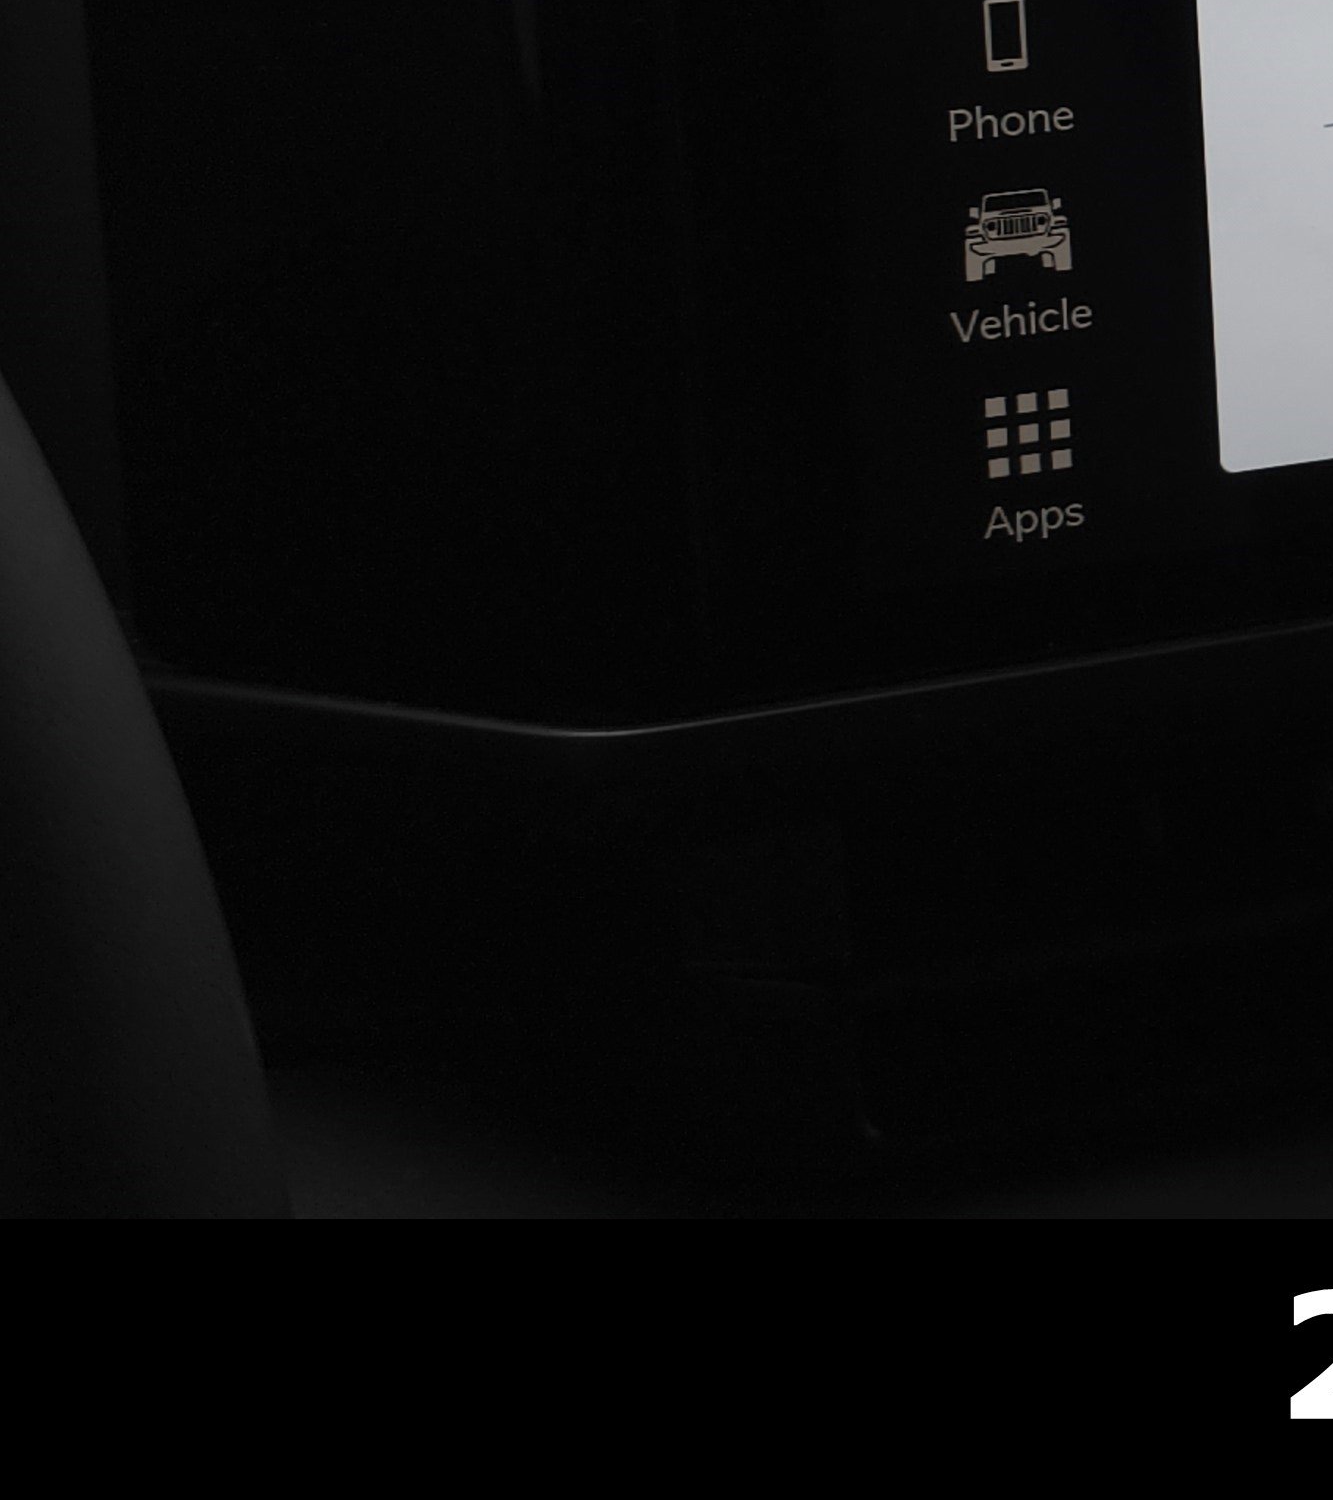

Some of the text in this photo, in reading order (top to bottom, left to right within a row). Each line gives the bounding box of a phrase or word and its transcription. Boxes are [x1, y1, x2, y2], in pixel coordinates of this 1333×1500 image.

[948, 102, 1075, 142] Phone
[949, 296, 1093, 344] Vehicle
[984, 499, 1085, 543] Apps
